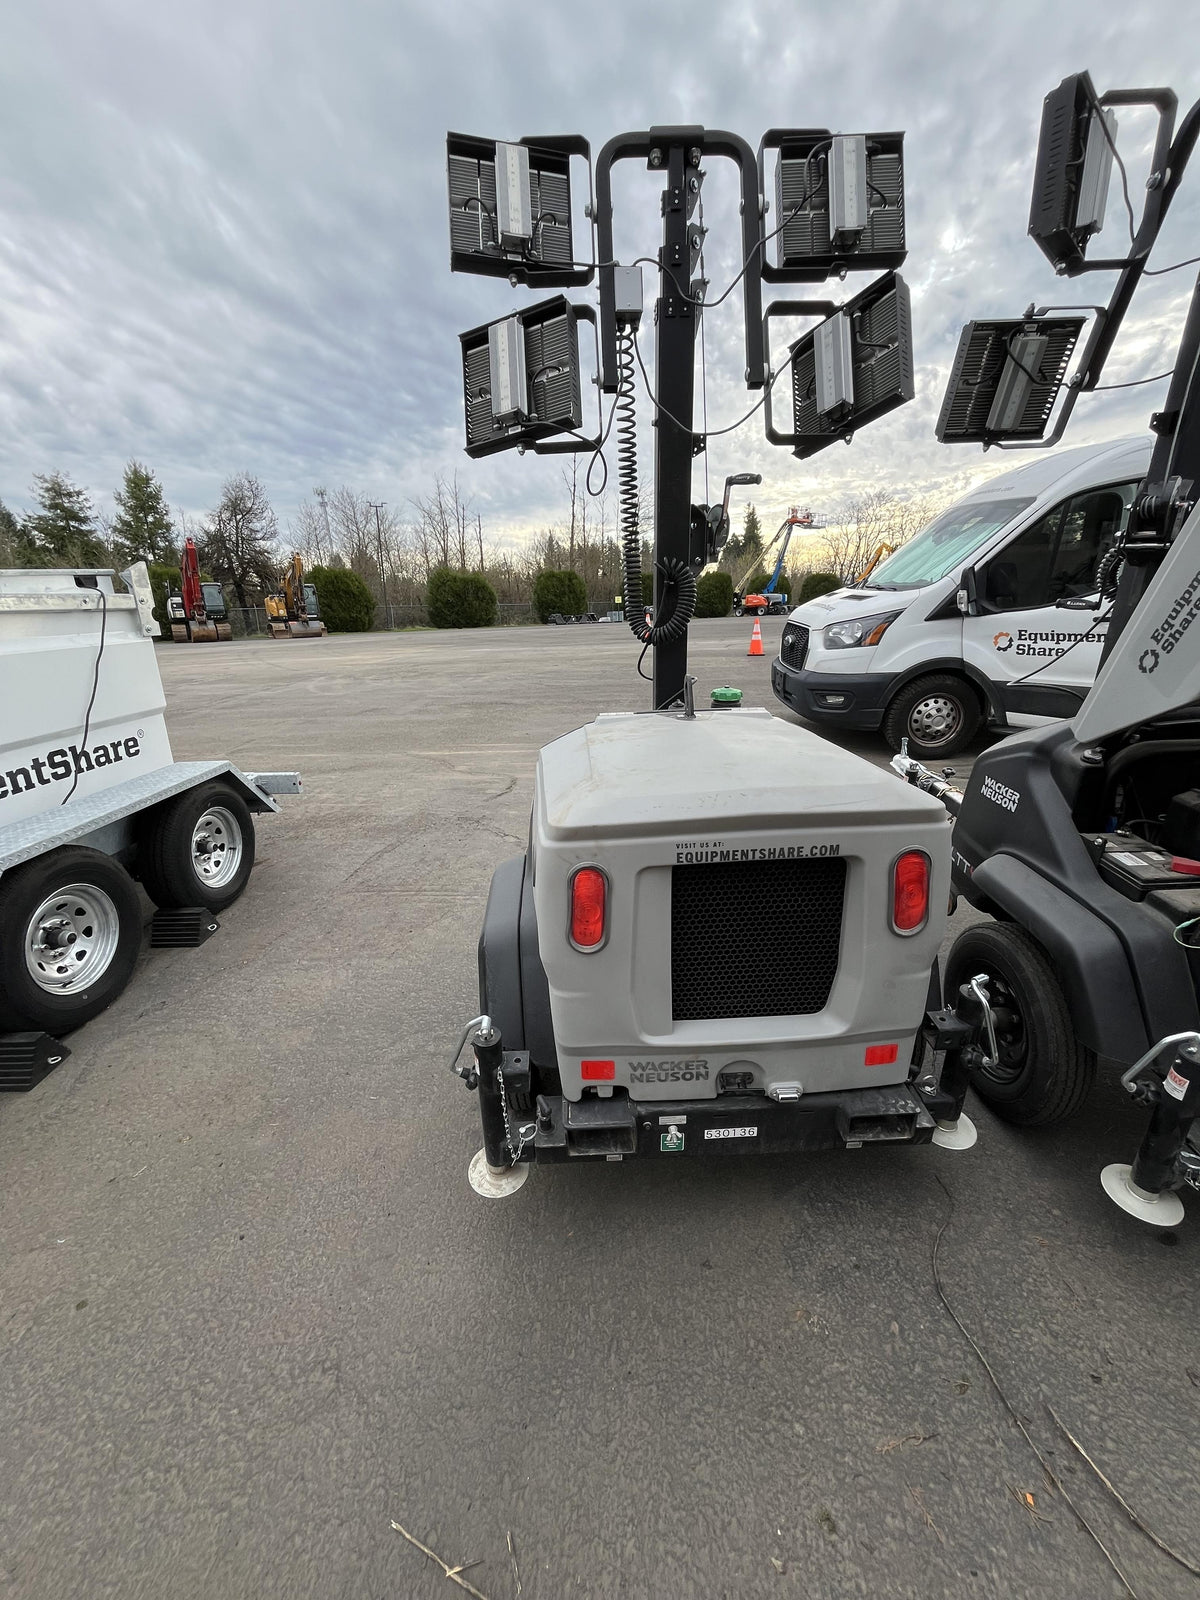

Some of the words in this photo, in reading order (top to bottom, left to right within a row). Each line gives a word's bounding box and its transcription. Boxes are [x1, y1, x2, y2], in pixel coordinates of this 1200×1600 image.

[1161, 597, 1200, 654] Share
[1015, 644, 1066, 657] Share
[984, 775, 1020, 804] WACKER
[980, 784, 1018, 813] NEUSON
[675, 842, 697, 850] VISIT
[676, 844, 841, 864] EQUIPMENTSHARE.COM
[628, 1060, 709, 1073] WACKER
[630, 1071, 709, 1084] NEUSON
[705, 1127, 756, 1139] 530136
